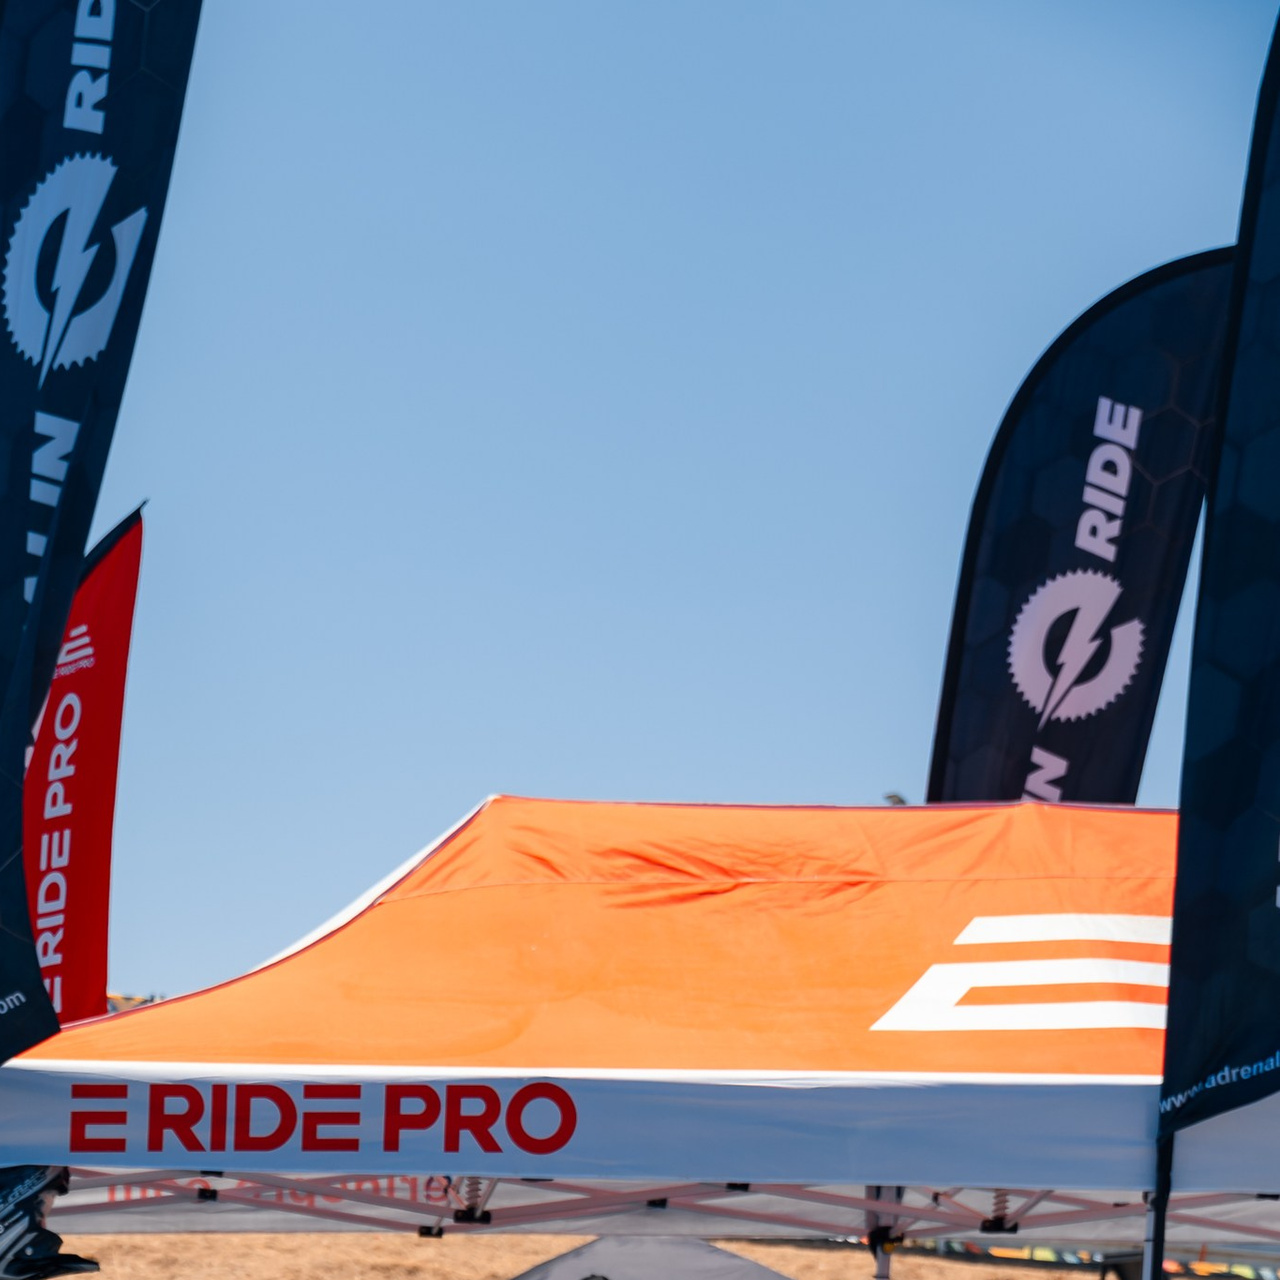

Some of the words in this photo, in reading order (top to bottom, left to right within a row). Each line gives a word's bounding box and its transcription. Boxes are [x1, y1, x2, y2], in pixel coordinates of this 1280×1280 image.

[1075, 396, 1144, 562] RIDE
[43, 692, 82, 821] PRO
[36, 828, 71, 969] RIDE
[70, 1084, 129, 1153] E
[148, 1084, 362, 1153] RIDE
[383, 1081, 578, 1155] PRO
